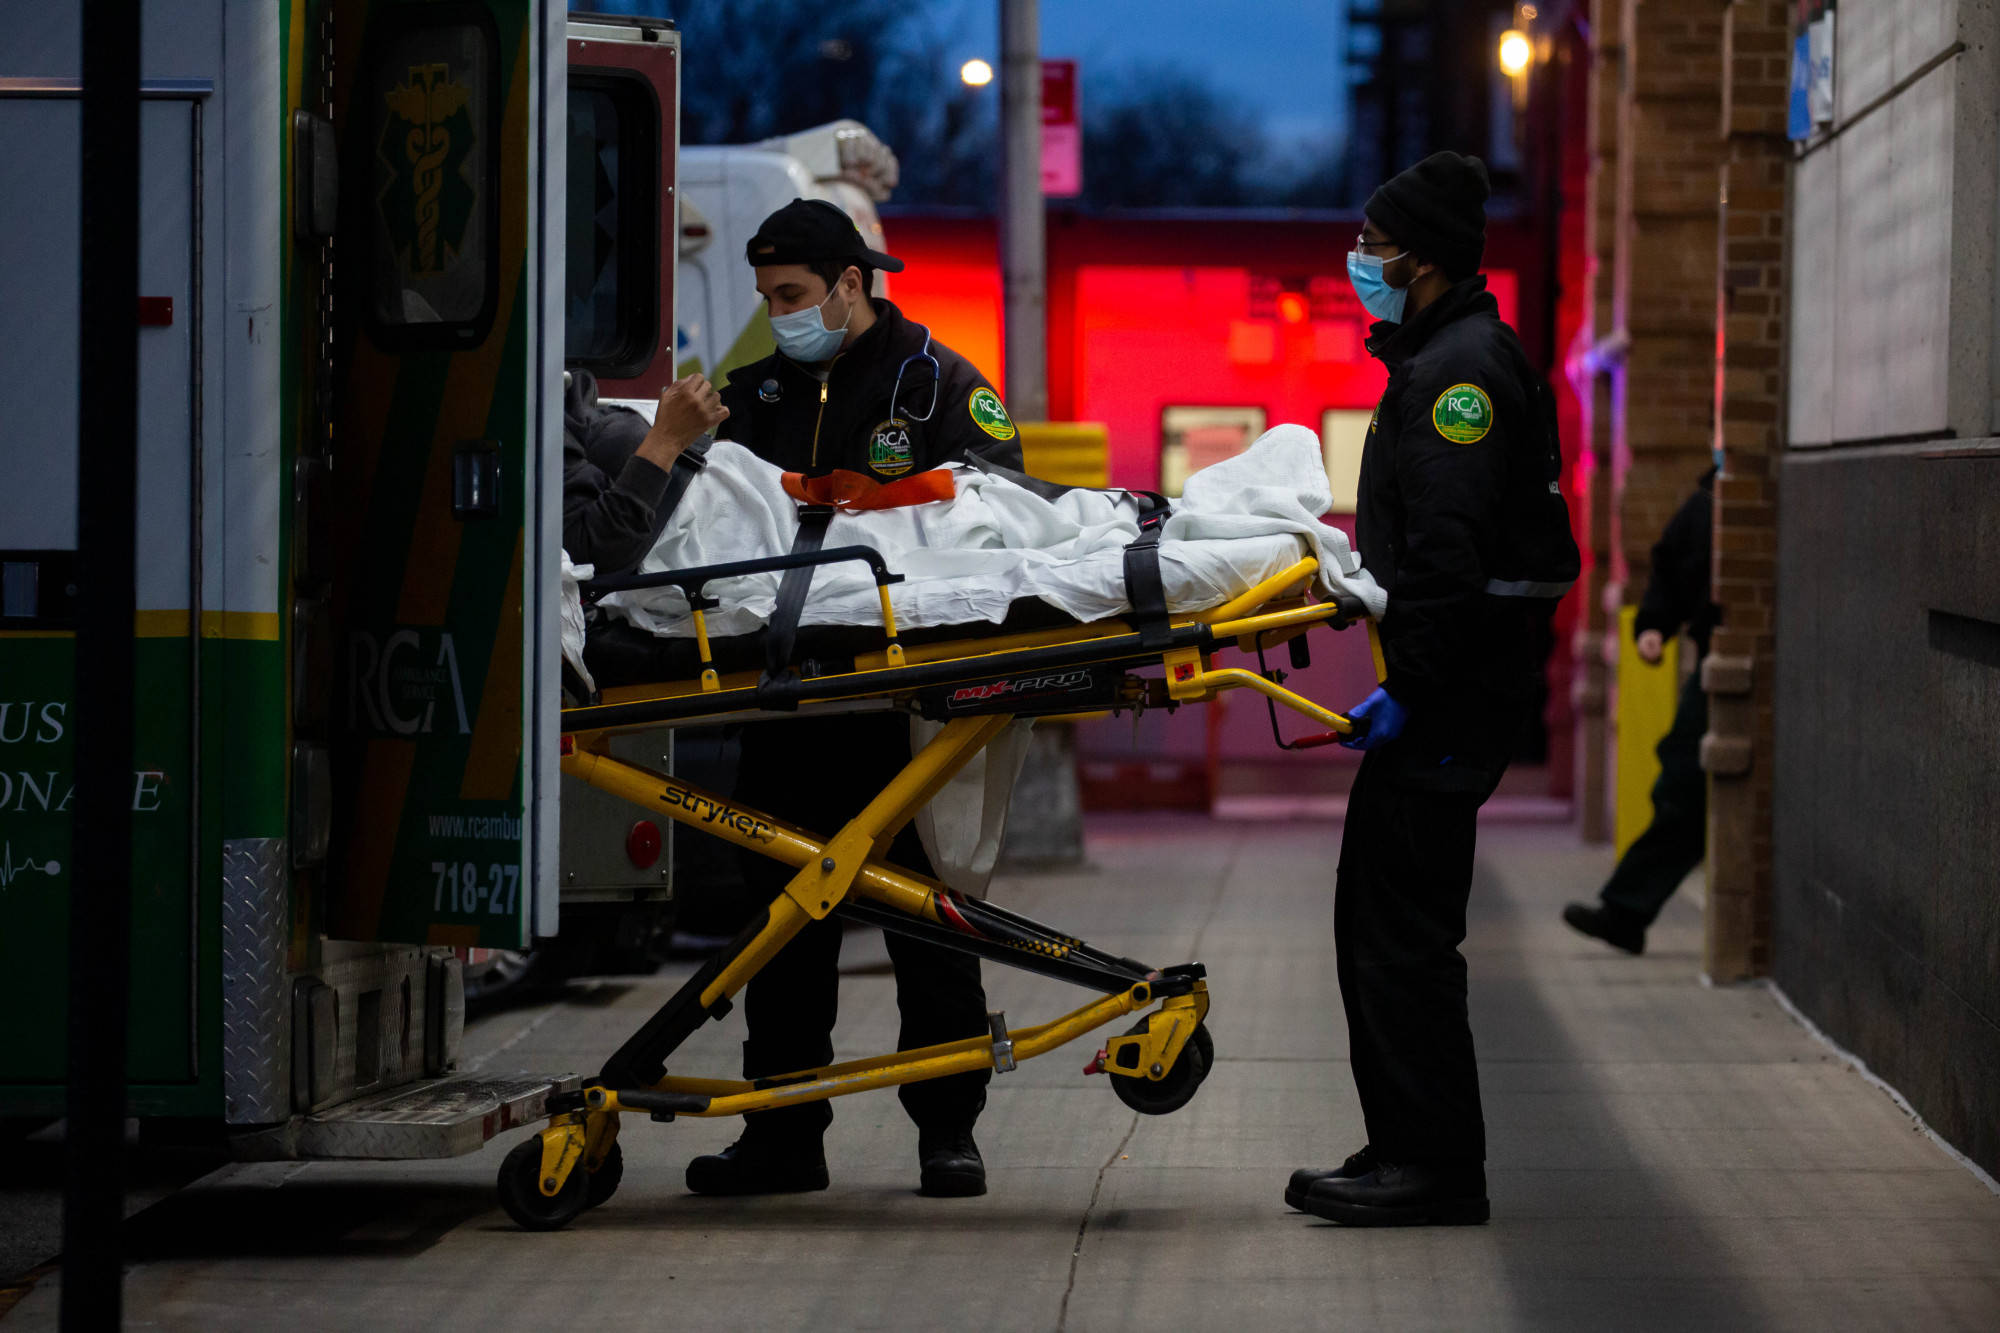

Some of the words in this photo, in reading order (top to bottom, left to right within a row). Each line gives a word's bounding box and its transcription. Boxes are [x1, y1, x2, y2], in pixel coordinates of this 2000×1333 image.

[978, 398, 1006, 420] RCA
[1447, 397, 1482, 415] RCA
[877, 430, 910, 448] RCA
[345, 629, 472, 735] RCA
[428, 811, 521, 840] www.rcambu
[431, 860, 519, 915] 718-27
